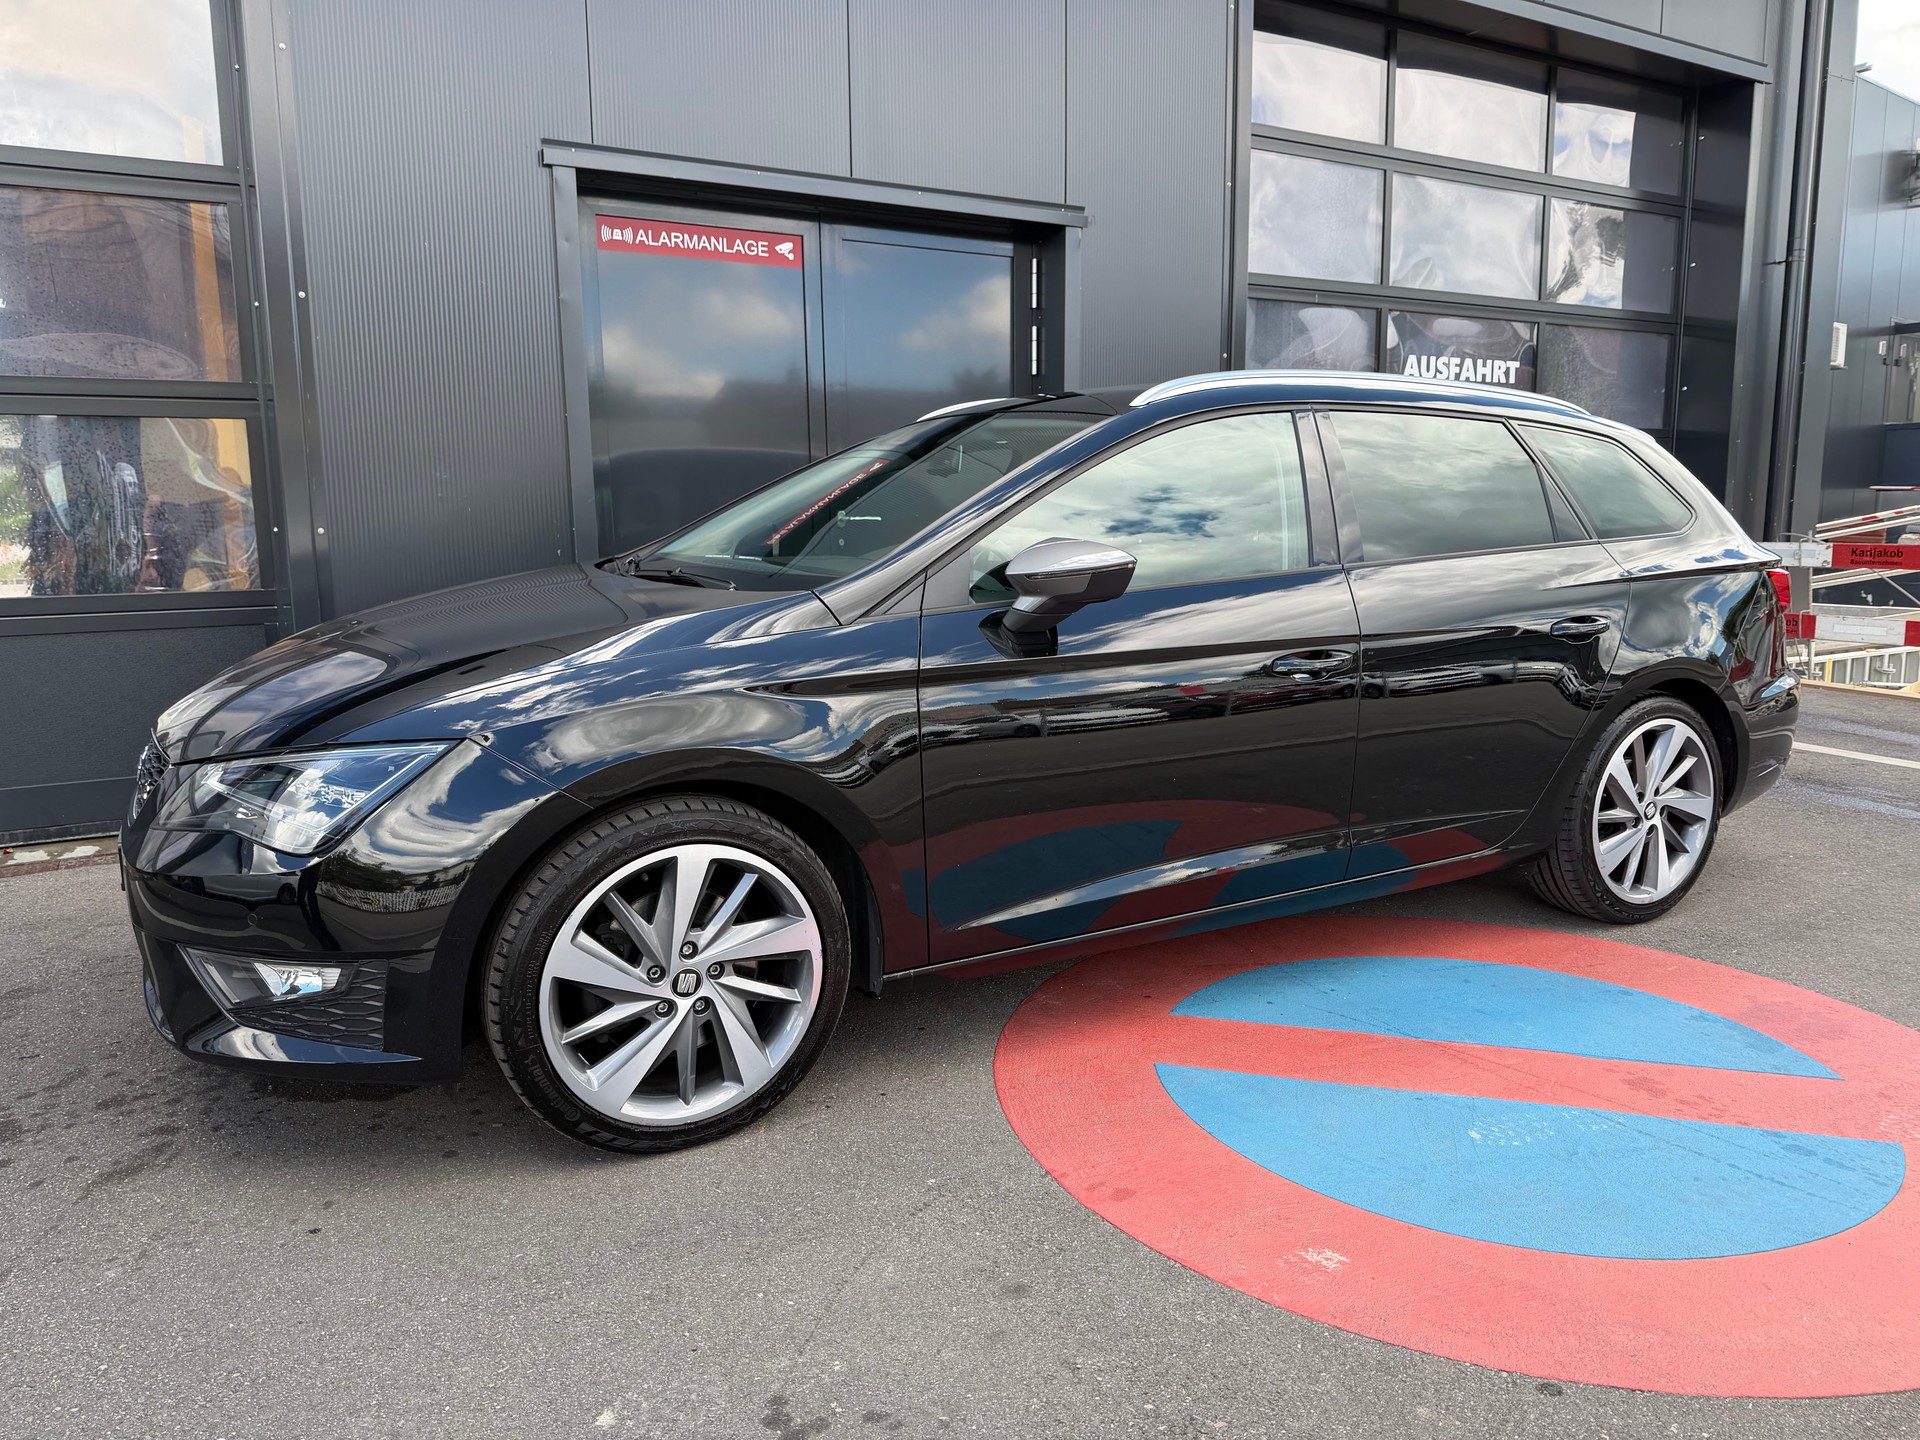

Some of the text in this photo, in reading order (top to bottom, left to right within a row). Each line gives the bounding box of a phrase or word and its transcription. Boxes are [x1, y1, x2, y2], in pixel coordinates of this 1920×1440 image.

[635, 229, 769, 257] ALARMANLAGE
[1403, 354, 1520, 384] AUSFAHRT
[527, 1063, 582, 1122] Continental
